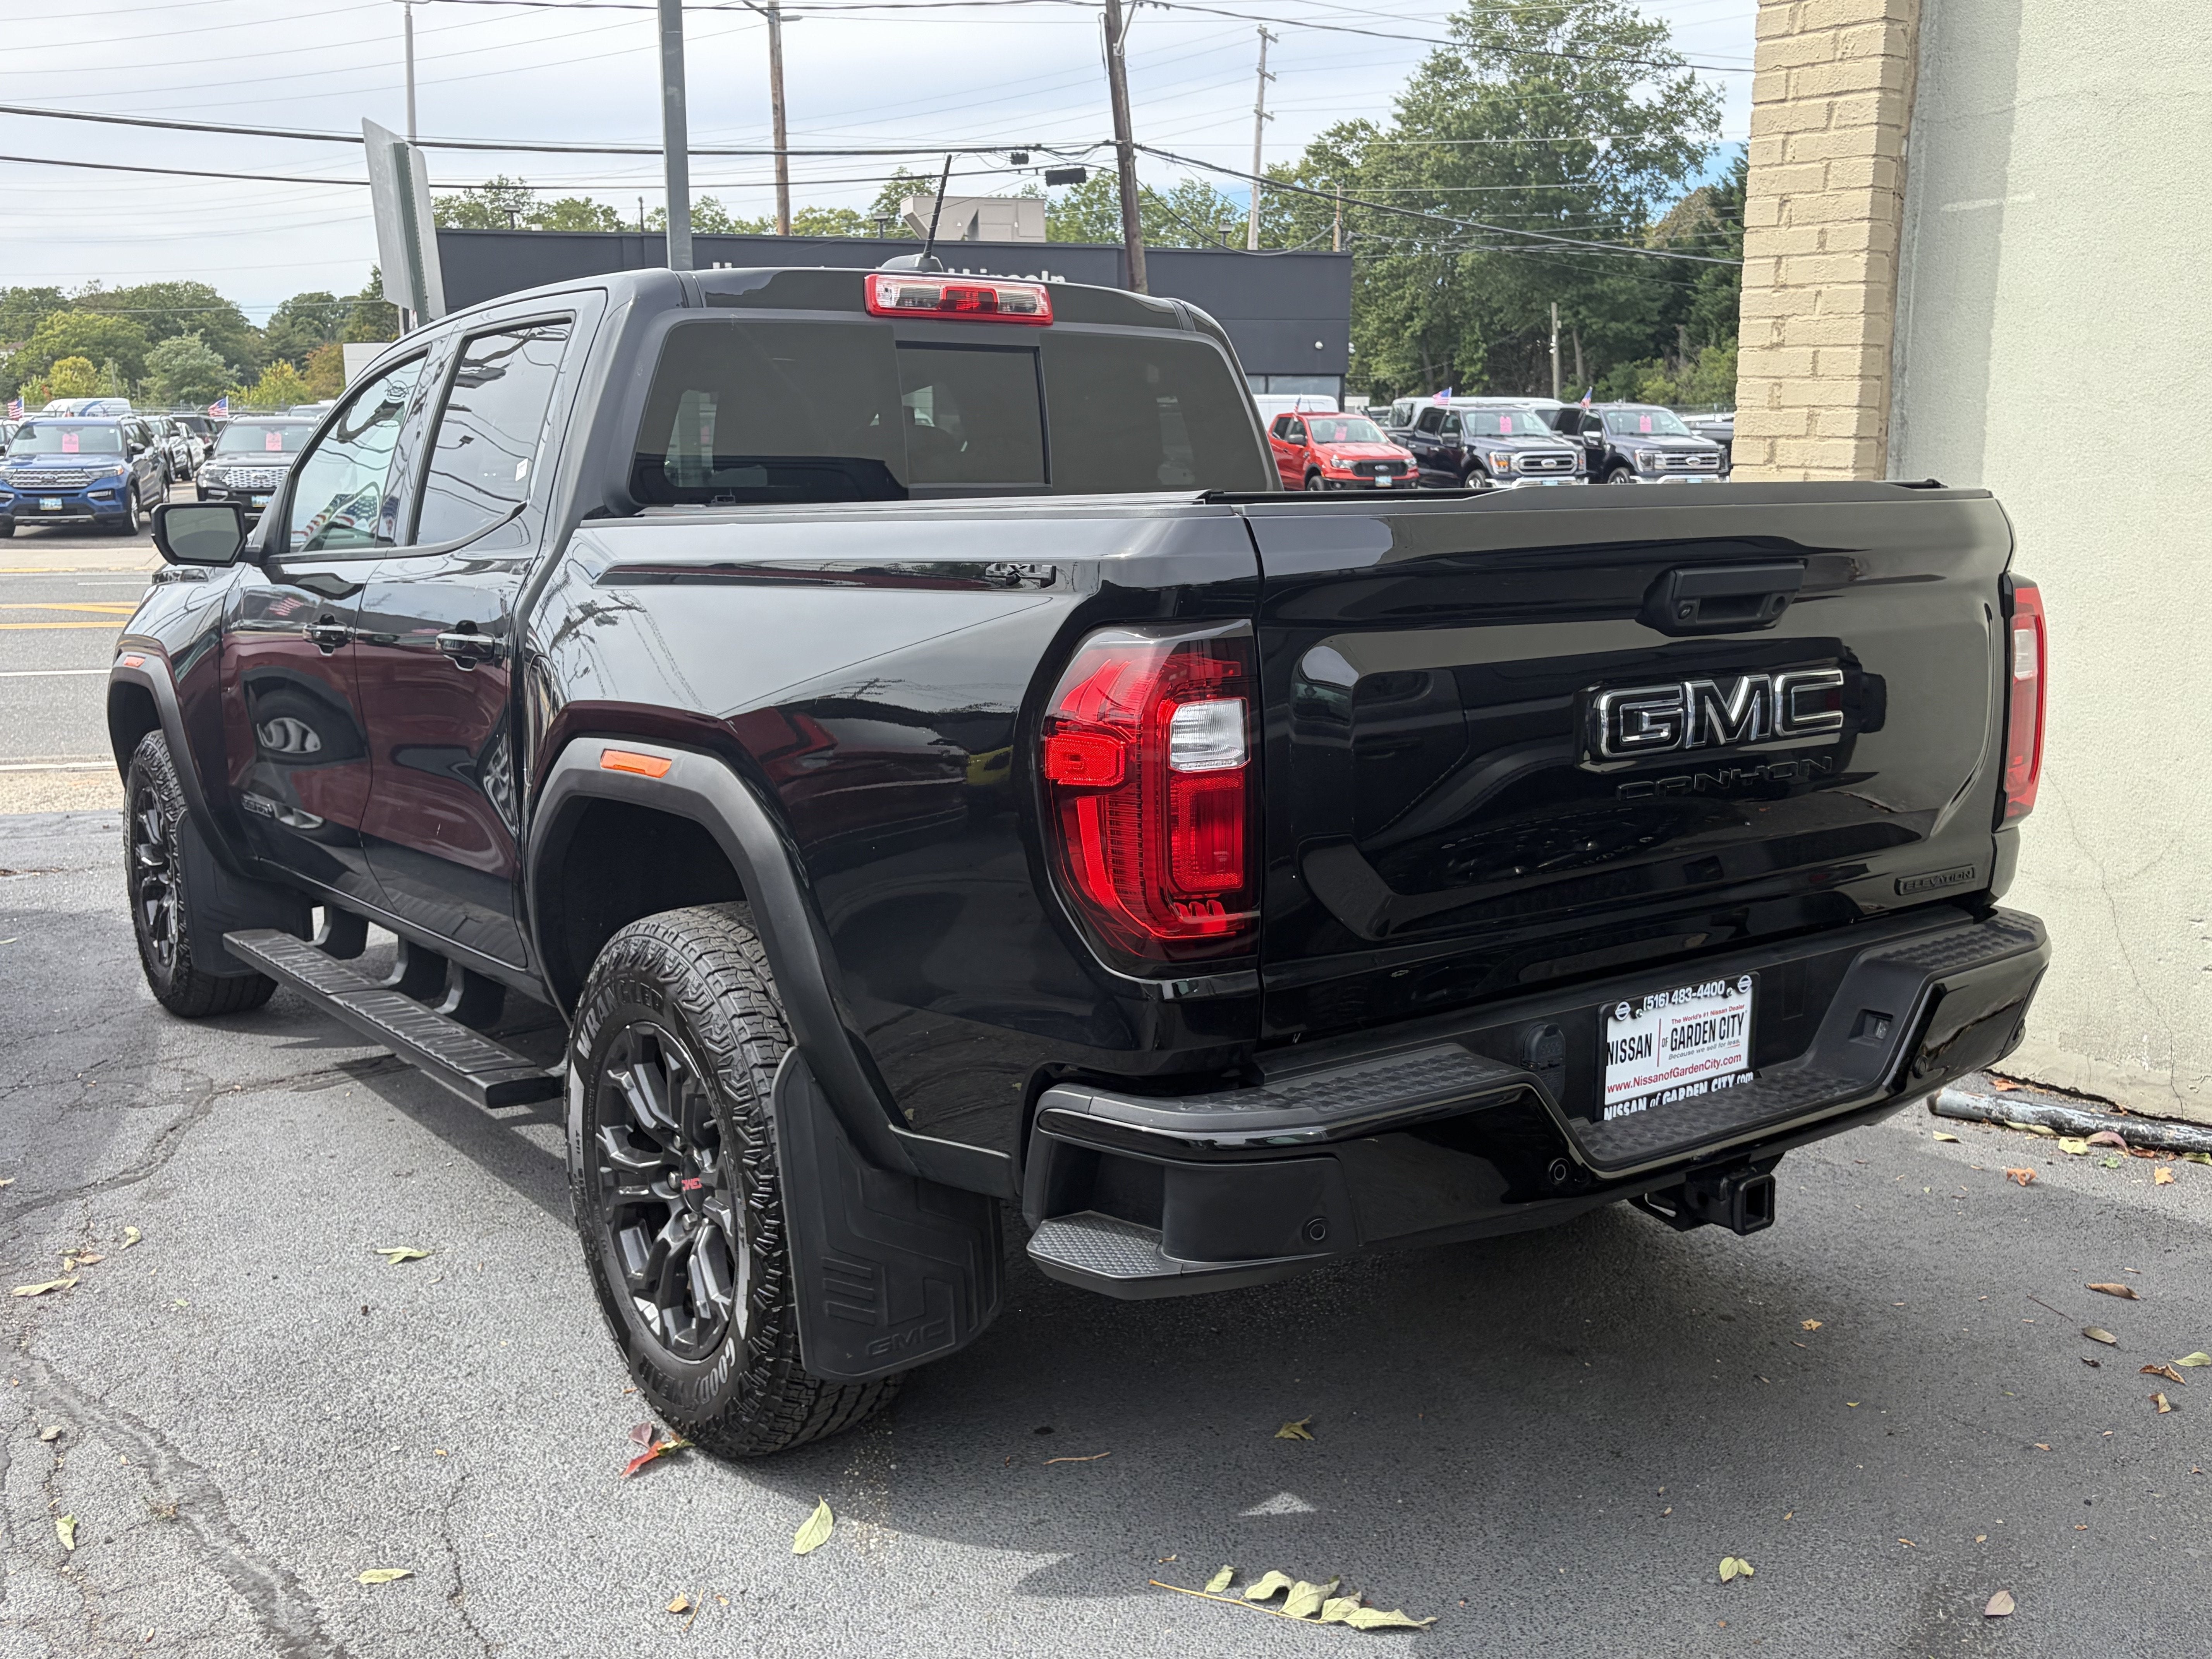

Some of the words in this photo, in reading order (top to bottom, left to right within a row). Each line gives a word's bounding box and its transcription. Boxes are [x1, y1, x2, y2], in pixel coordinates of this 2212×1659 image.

[1597, 668, 1844, 758] GMC
[1903, 871, 1971, 891] ELEVATION
[1644, 992, 1669, 1011] (516)
[1671, 980, 1725, 1004] 483-4400
[576, 981, 665, 1060] WRANGLER
[1661, 1037, 1669, 1048] OF
[1670, 1018, 1716, 1052] GARDEN
[1719, 1012, 1745, 1040] CITY
[1683, 1013, 1702, 1022] World's
[1710, 1008, 1728, 1016] Nissan
[1607, 1033, 1652, 1066] NISSAN
[1668, 1050, 1695, 1060] Because
[1607, 1054, 1741, 1093] www.NissanofGardenCity.com
[1604, 1097, 1647, 1121] NISSAN
[1649, 1092, 1662, 1108] of
[1662, 1081, 1708, 1105] GARDEN
[866, 1320, 945, 1355] GMC
